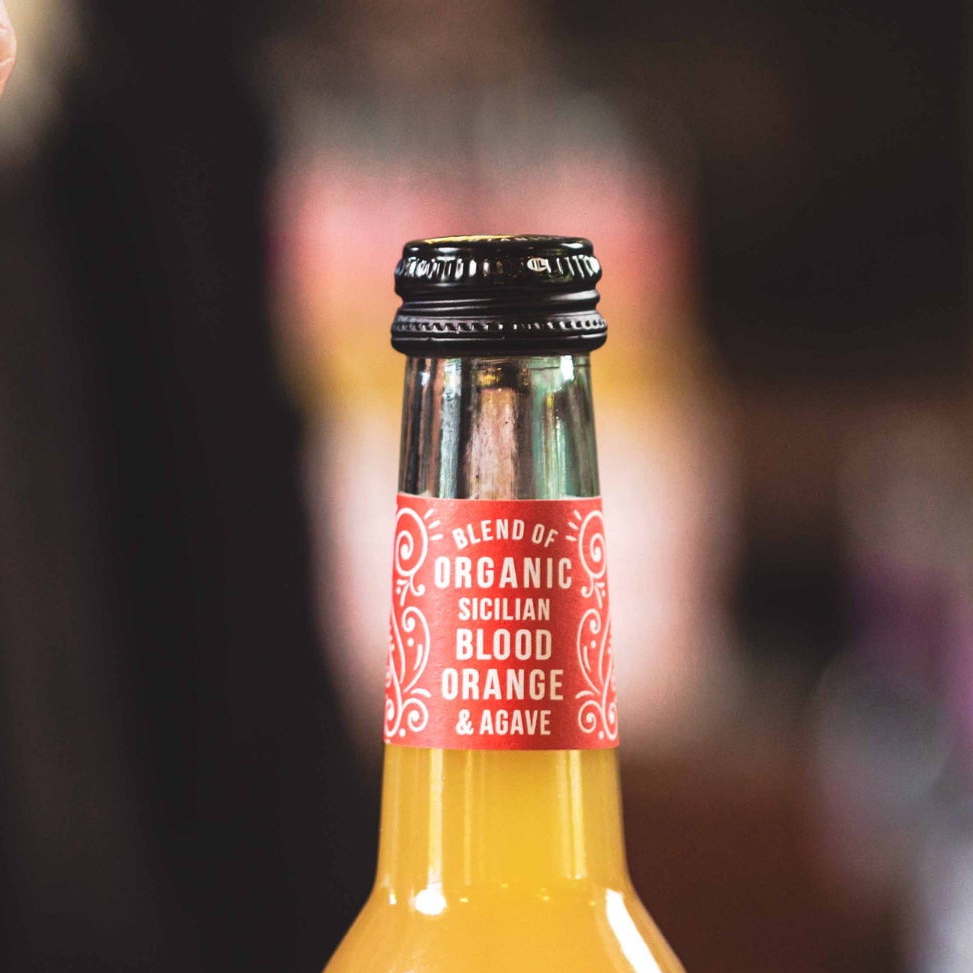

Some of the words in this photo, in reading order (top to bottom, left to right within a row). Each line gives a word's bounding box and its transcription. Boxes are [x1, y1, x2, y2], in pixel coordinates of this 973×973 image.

[451, 518, 525, 550] BLEND
[531, 523, 559, 548] OF
[434, 556, 573, 589] ORGANIC
[458, 597, 550, 621] SICILIAN
[456, 628, 553, 661] BLOOD
[441, 668, 564, 701] ORANGE
[455, 708, 474, 736] &
[479, 709, 552, 736] AGAVE
